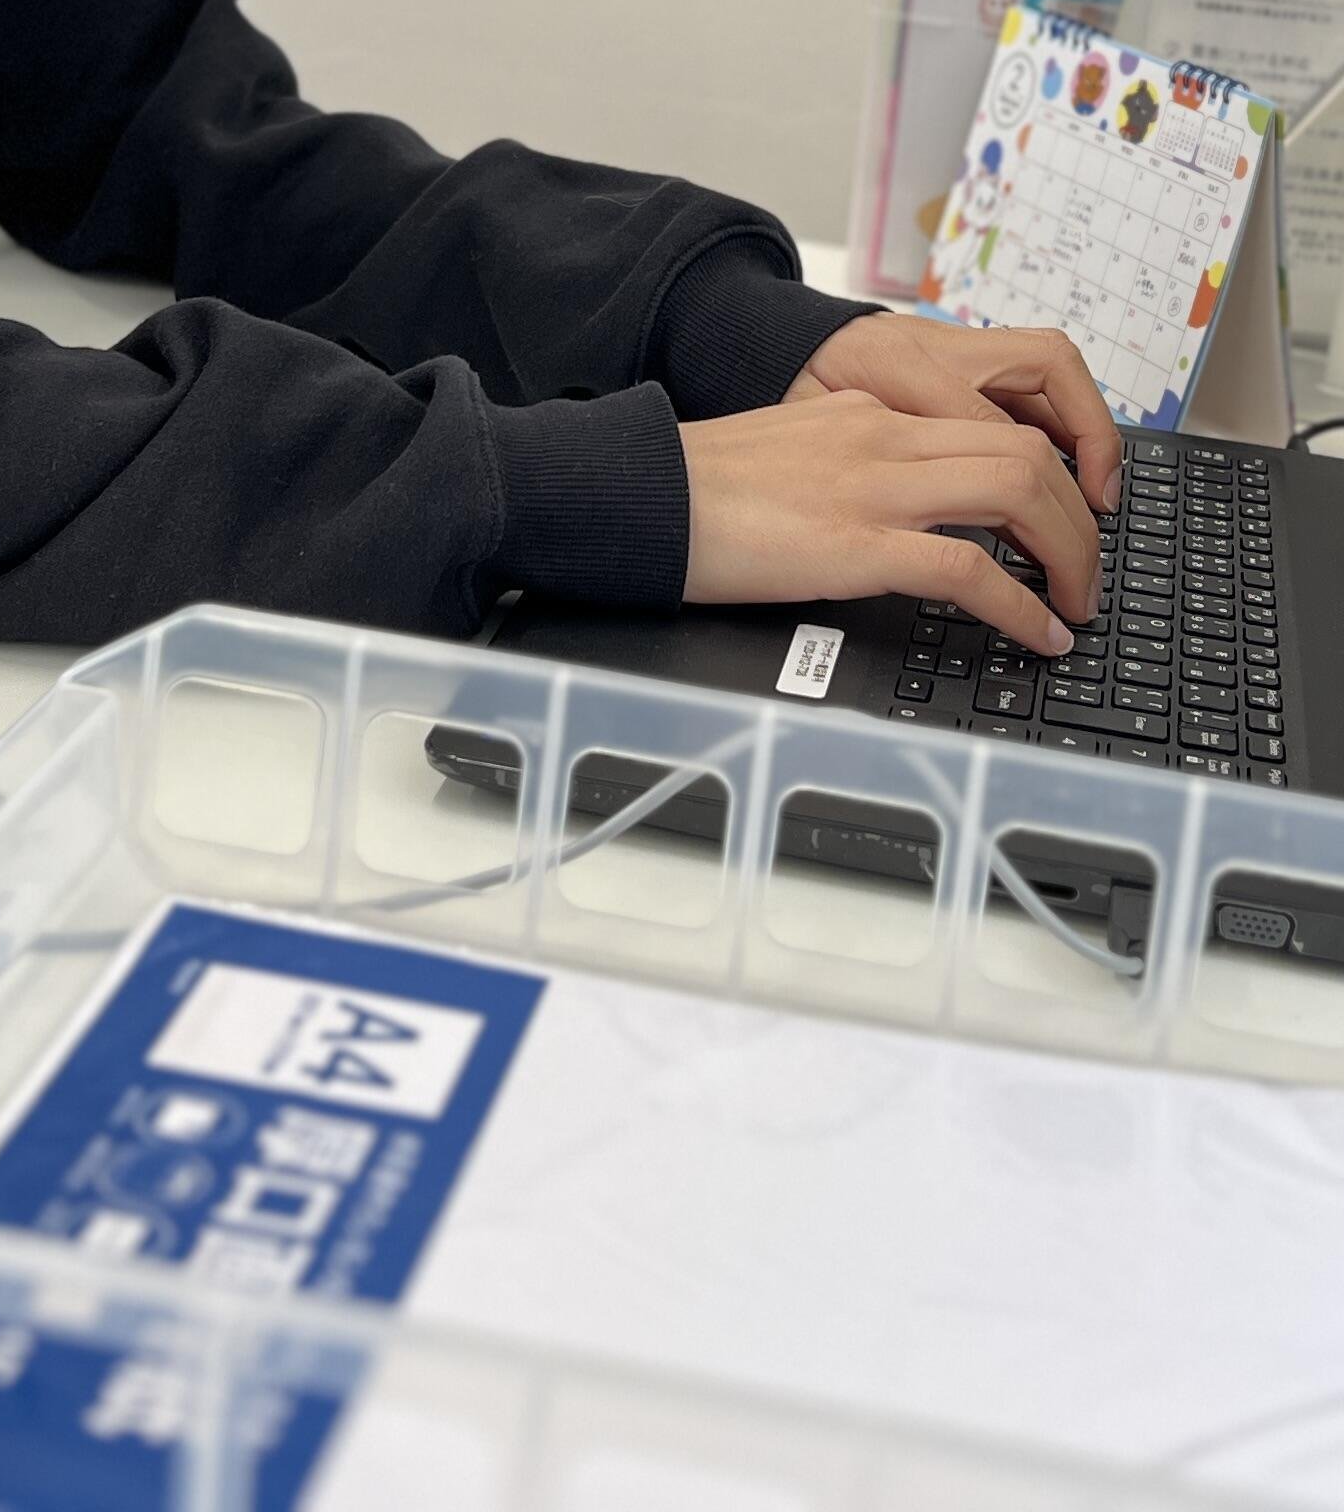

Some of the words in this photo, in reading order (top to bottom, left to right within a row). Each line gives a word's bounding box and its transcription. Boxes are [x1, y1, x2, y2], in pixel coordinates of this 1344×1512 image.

[1207, 183, 1220, 193] SAT
[1182, 238, 1191, 249] 10
[1113, 253, 1121, 263] 15
[1140, 267, 1148, 276] 16
[1169, 280, 1177, 290] 17
[1127, 307, 1136, 318] 23
[1155, 322, 1163, 332] 24
[1150, 642, 1165, 650] P
[1136, 716, 1147, 731] Enter
[1062, 737, 1076, 745] 4
[1132, 749, 1147, 757] 7
[1268, 768, 1281, 784] PgUp
[304, 1000, 418, 1089] A4
